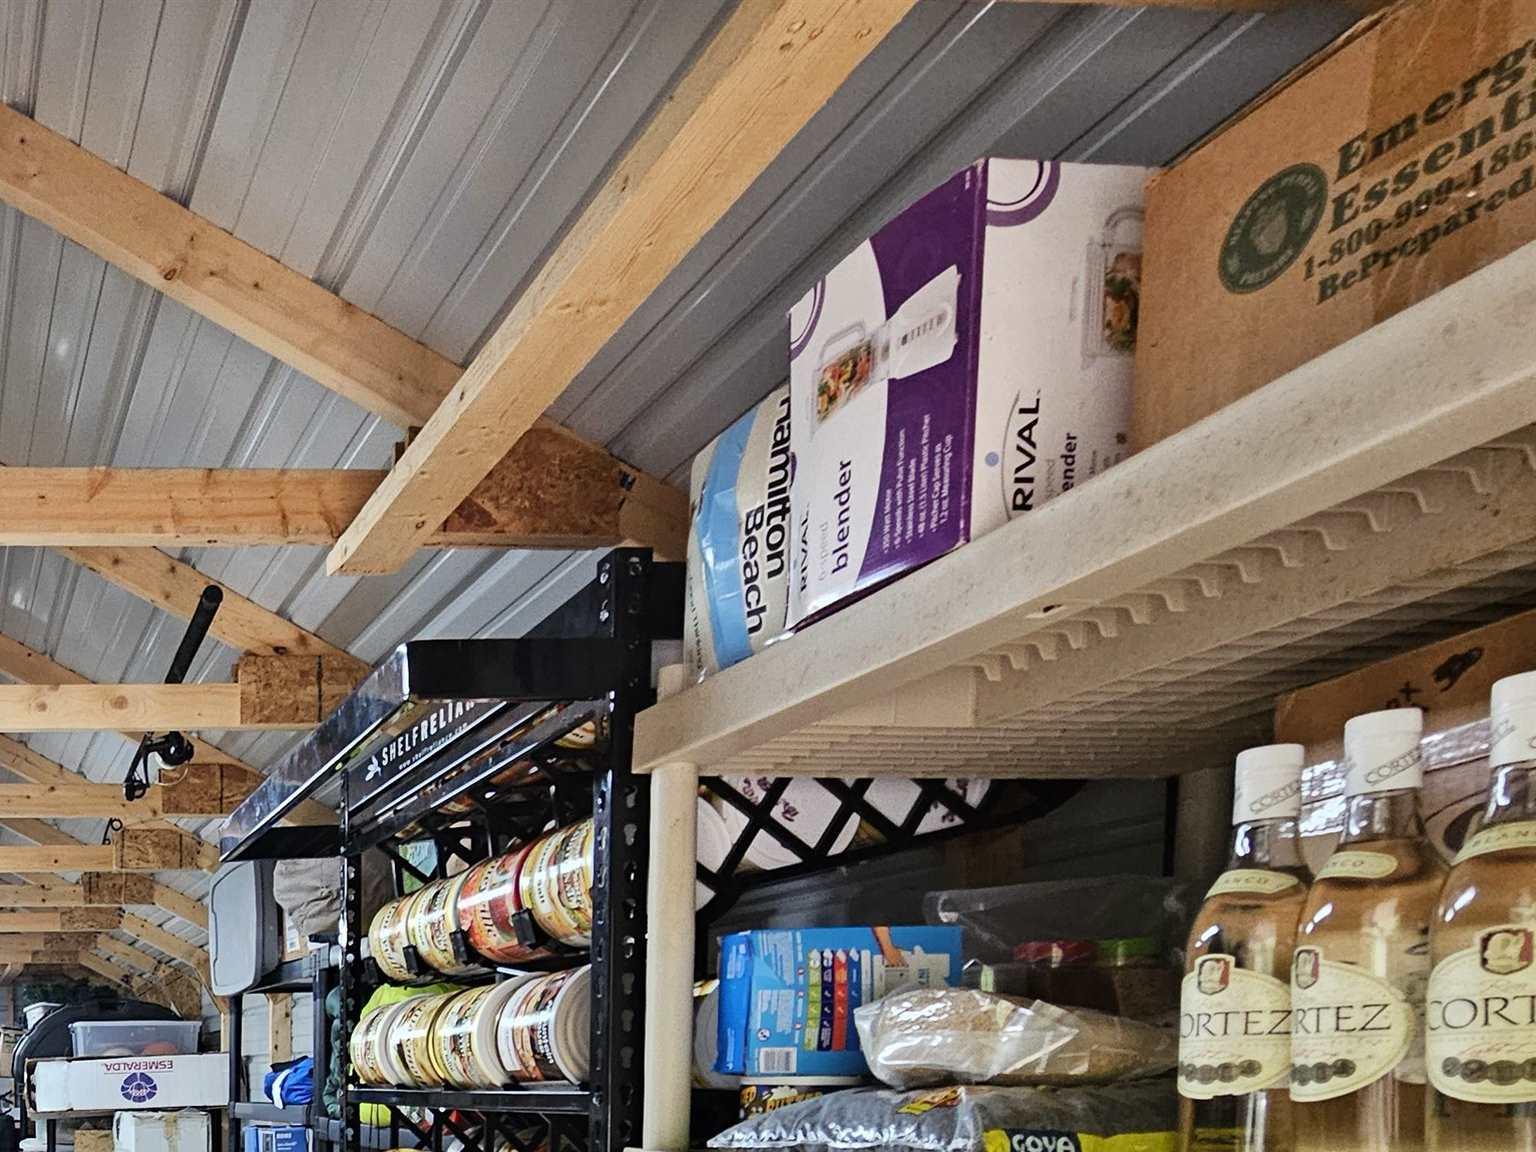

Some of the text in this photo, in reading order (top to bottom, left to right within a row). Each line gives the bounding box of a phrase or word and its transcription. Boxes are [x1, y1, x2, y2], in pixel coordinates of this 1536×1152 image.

[1334, 38, 1536, 183] Emerg
[1012, 397, 1040, 511] RIVAL
[1061, 432, 1077, 491] ender
[832, 459, 852, 575] blender
[742, 503, 767, 634] Beach
[1182, 1008, 1292, 1039] ORTEZ
[1294, 1002, 1391, 1033] RTEZ
[1429, 994, 1536, 1032] CORT
[104, 1060, 174, 1071] ESMERALDA
